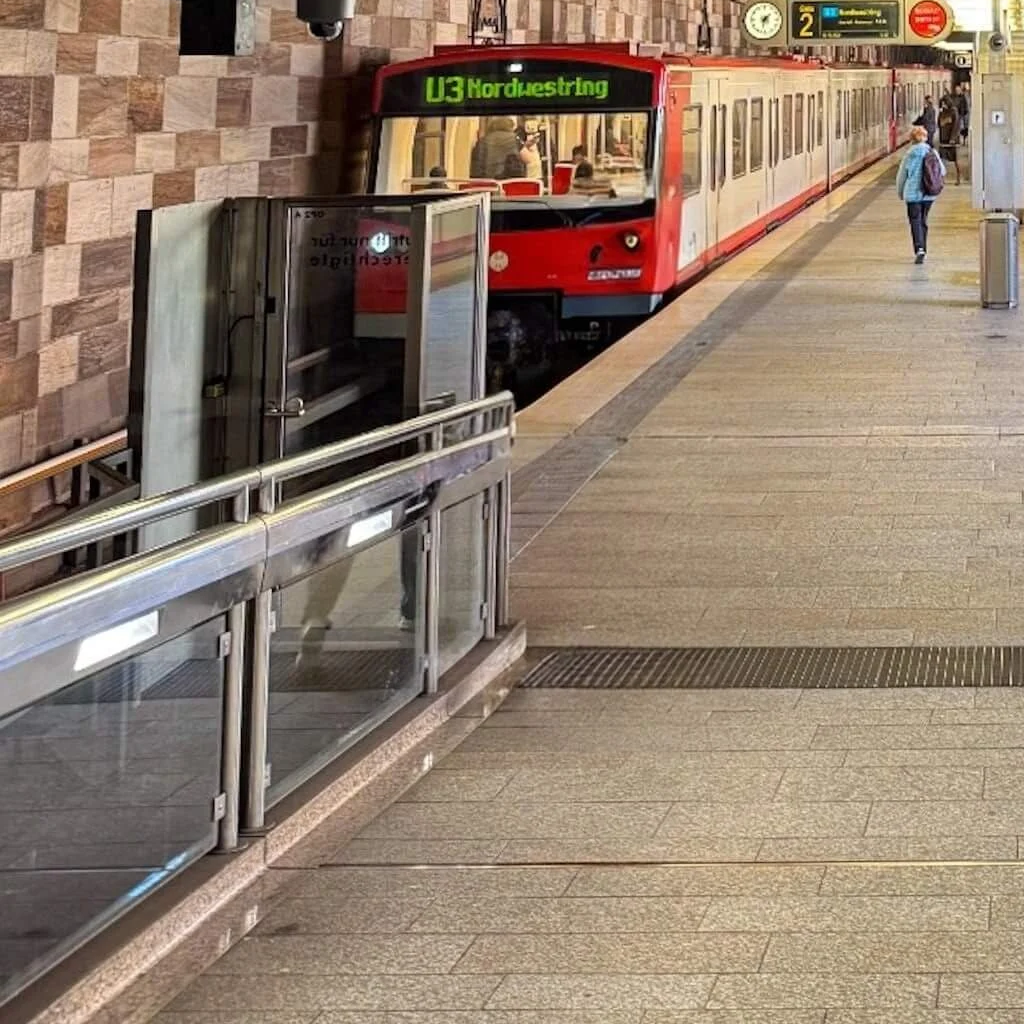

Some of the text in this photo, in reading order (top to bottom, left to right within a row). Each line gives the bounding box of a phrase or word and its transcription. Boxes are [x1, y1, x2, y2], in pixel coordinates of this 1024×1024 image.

[799, 12, 814, 38] 2
[424, 75, 609, 104] U3 Nordwestring
